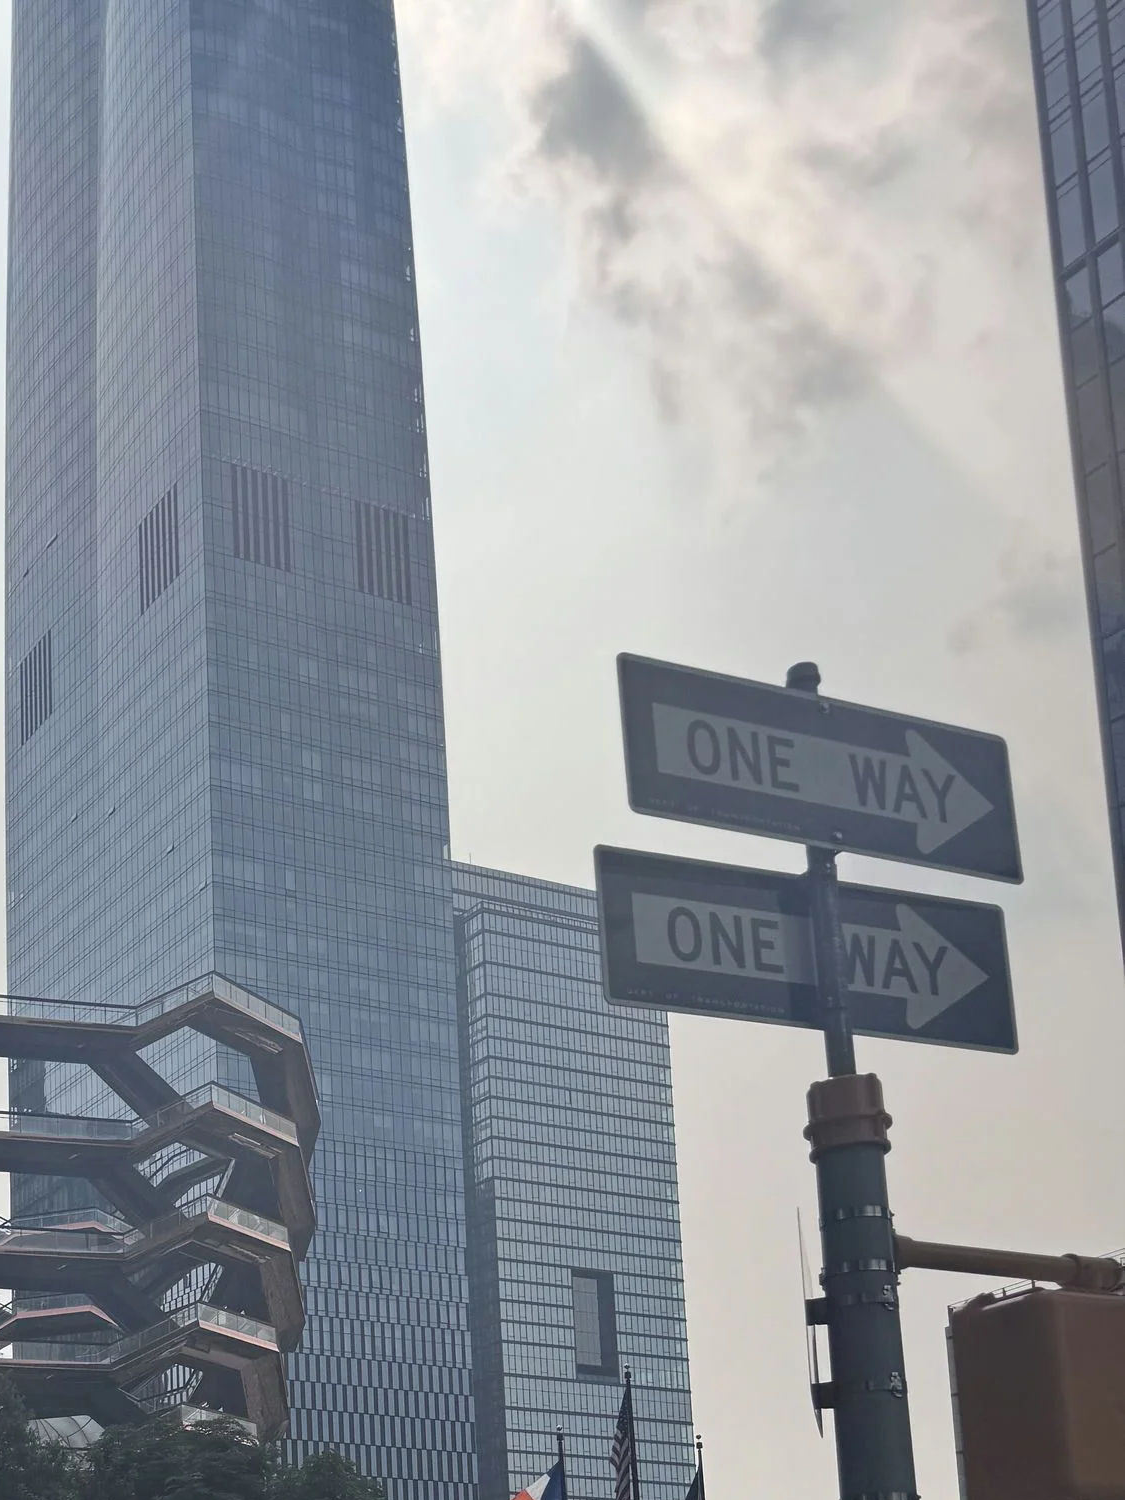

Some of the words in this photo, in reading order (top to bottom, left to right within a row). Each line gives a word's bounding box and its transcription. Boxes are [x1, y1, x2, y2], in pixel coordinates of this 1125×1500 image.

[686, 719, 800, 794] ONE
[849, 752, 956, 824] WAY
[667, 906, 785, 975] ONE
[845, 932, 949, 998] WAY
